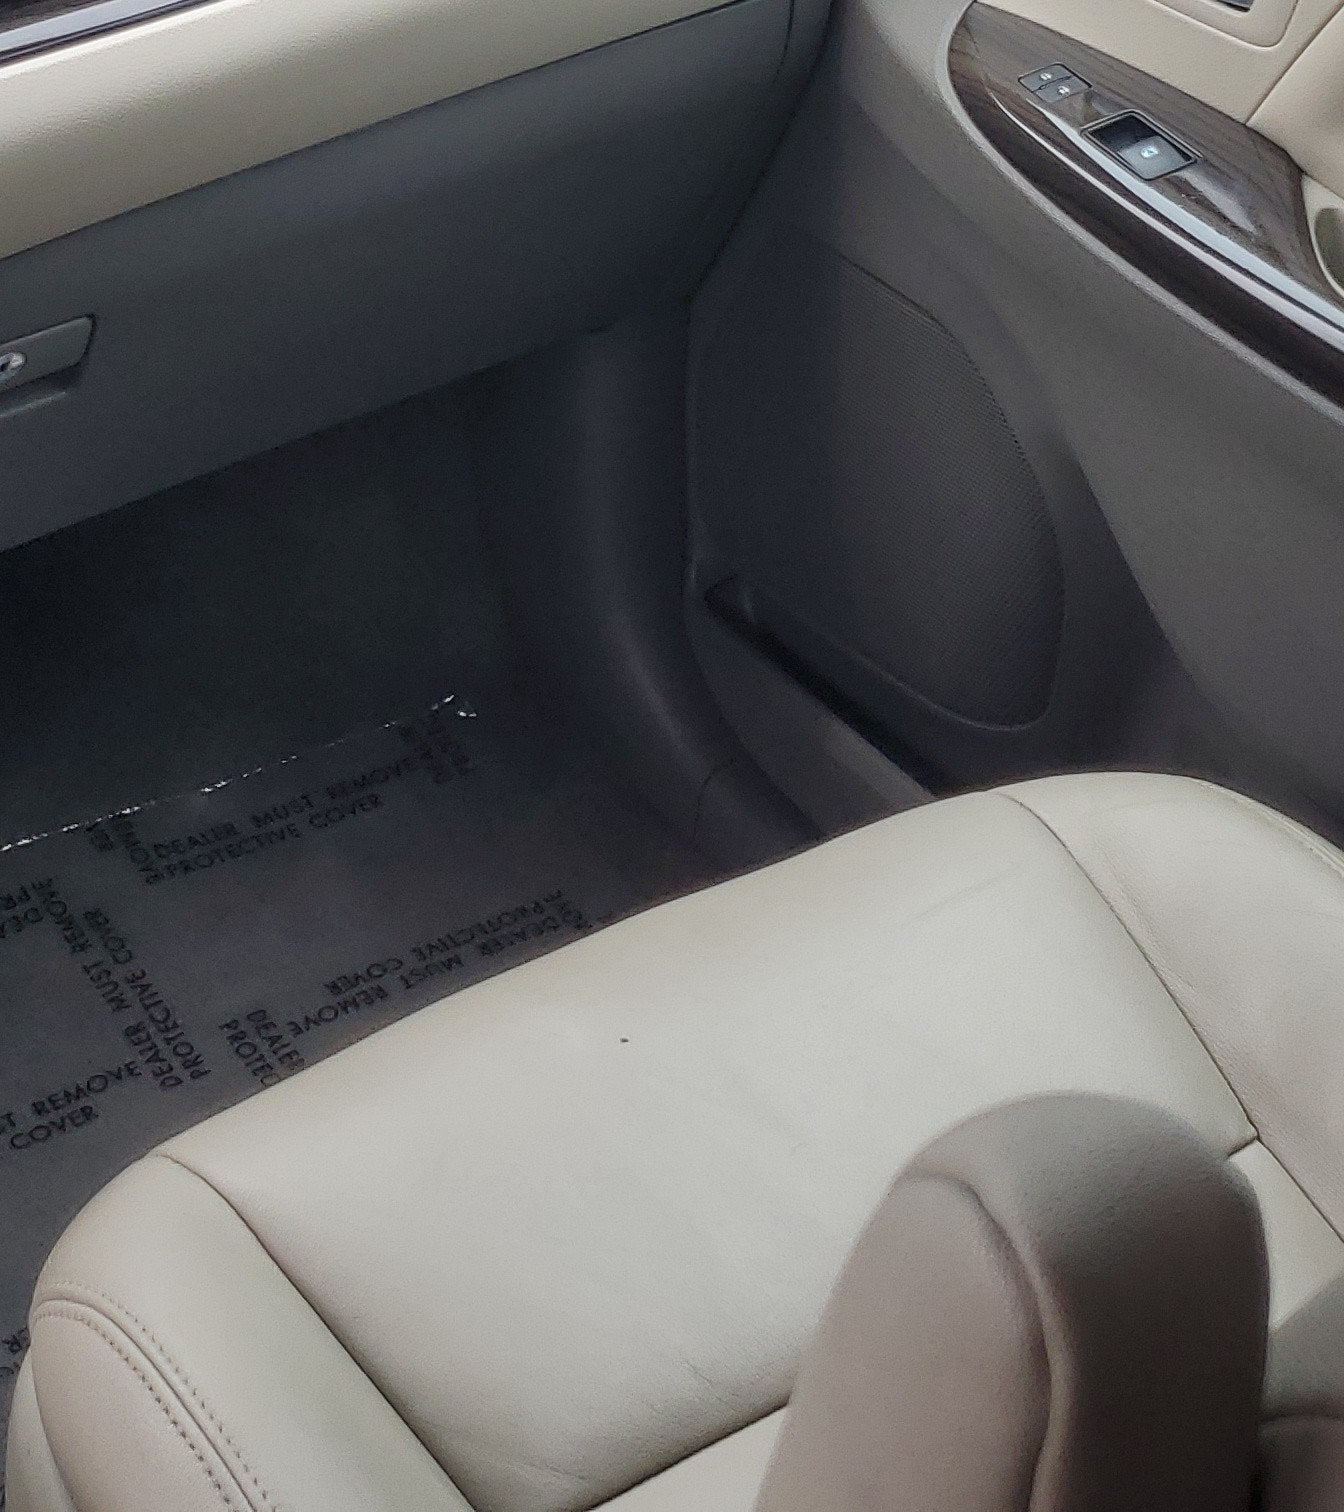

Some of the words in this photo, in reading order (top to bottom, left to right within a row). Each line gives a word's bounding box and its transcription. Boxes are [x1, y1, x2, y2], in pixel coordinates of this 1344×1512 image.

[123, 968, 212, 1081] PROTECTIVE
[285, 982, 390, 1039] REMOVE
[31, 1060, 144, 1117] REMOVE
[8, 1104, 100, 1152] COVER
